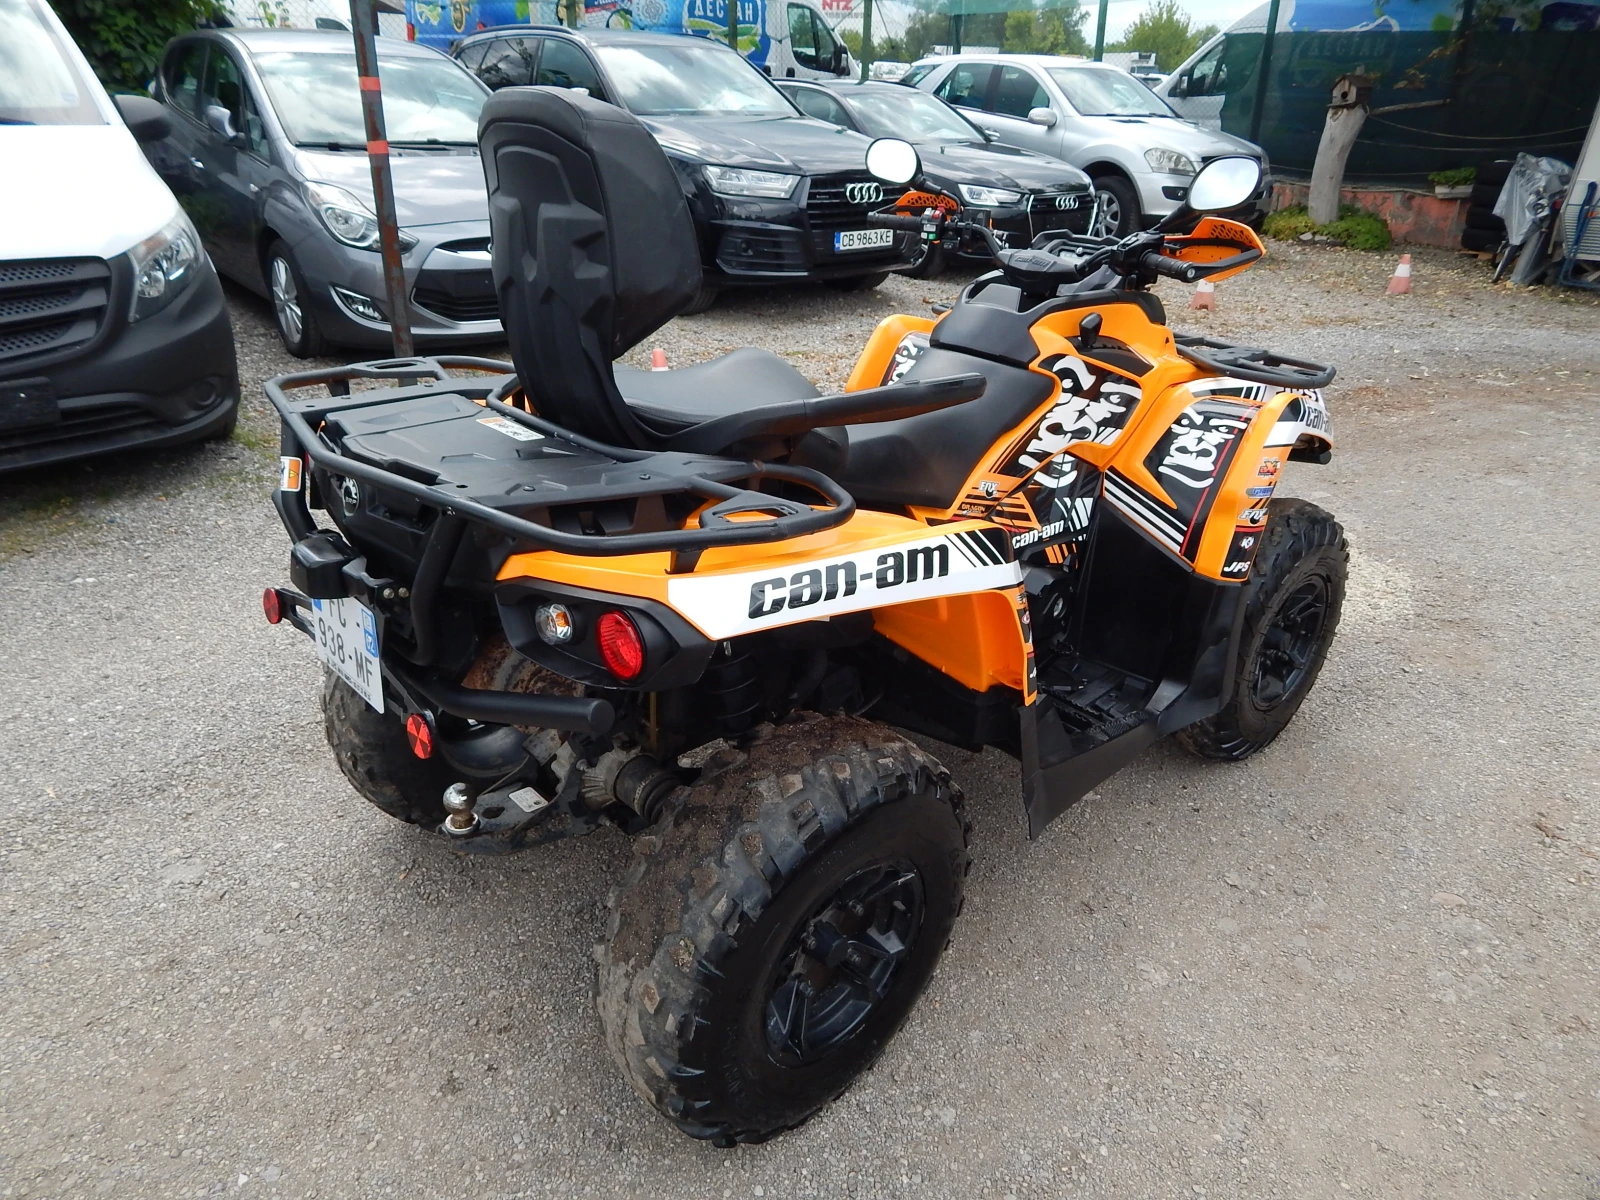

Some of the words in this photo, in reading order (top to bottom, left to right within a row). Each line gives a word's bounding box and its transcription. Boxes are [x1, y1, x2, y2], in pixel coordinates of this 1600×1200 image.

[694, 0, 753, 22] ДЕСАН
[842, 233, 855, 247] CB
[857, 231, 879, 246] 9863
[880, 230, 892, 244] KE
[1012, 520, 1065, 549] can-am
[1223, 561, 1251, 573] JPS
[748, 544, 949, 619] can-am
[318, 617, 373, 688] 938-MF
